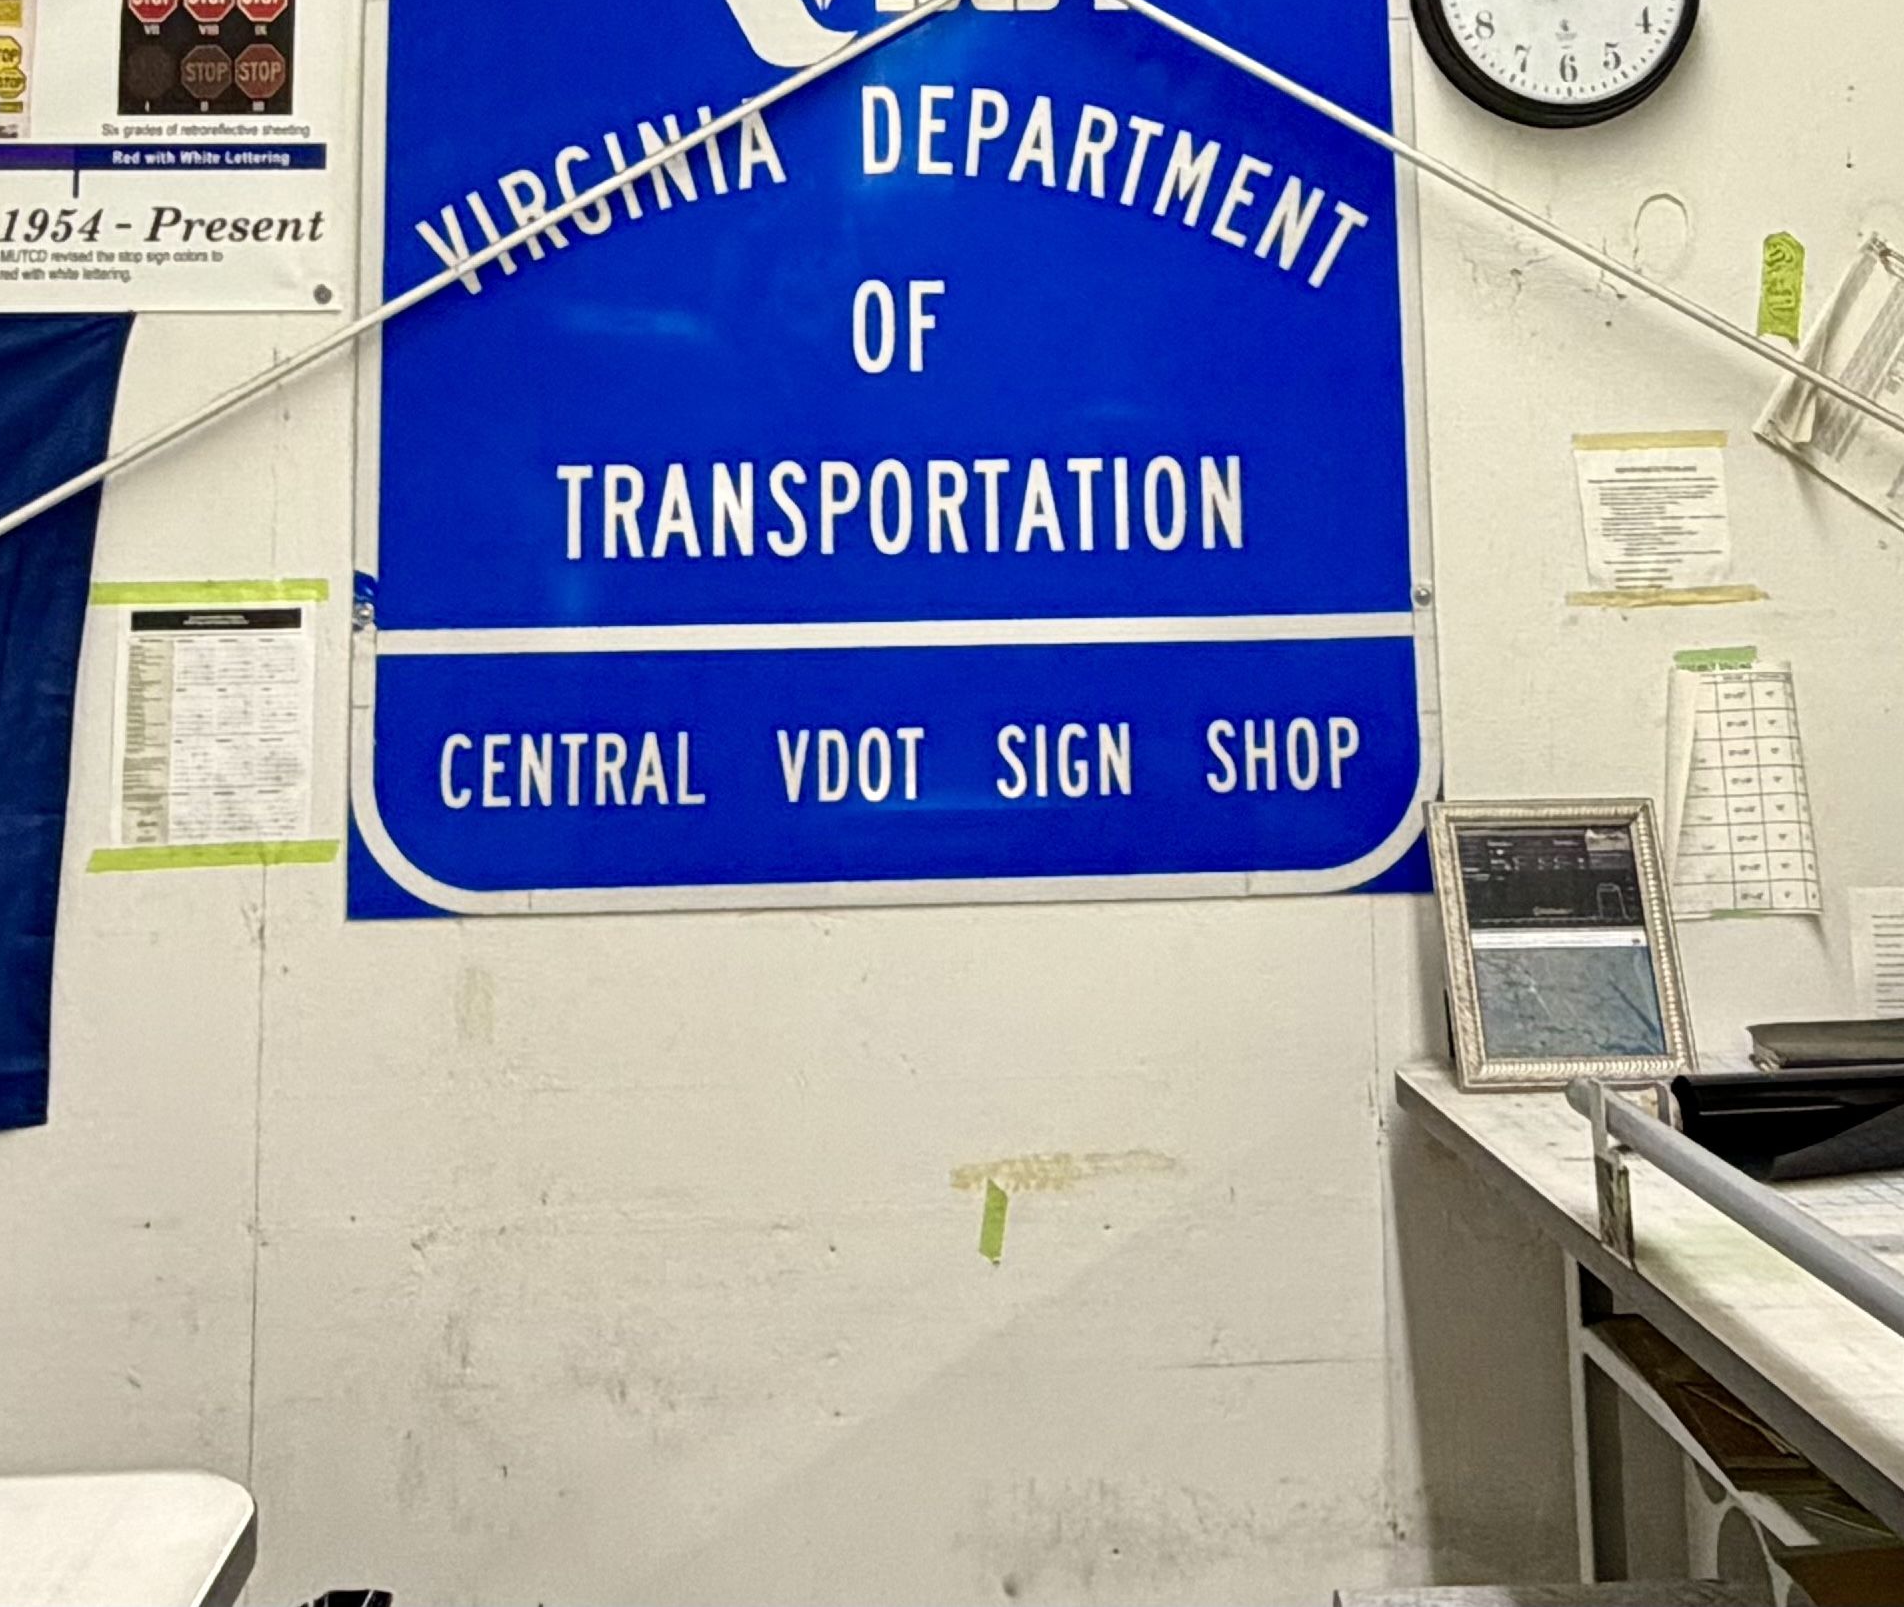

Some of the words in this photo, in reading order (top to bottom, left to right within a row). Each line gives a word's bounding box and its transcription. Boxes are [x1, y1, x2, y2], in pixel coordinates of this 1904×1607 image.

[1475, 10, 1495, 39] 8
[1635, 6, 1653, 34] 4
[239, 61, 282, 81] STOP
[1514, 44, 1531, 73] 7
[1560, 54, 1578, 83] 6
[1603, 43, 1621, 71] 5
[185, 62, 228, 82] STOP
[112, 150, 140, 165] Red
[145, 150, 176, 165] with
[180, 150, 221, 165] White
[225, 150, 290, 167] Lettering
[415, 99, 786, 294] VIRGINIA
[862, 85, 1367, 288] DEPARTMENT
[143, 205, 325, 243] Present
[852, 280, 945, 373] OF
[558, 455, 1243, 559] TRANSPORTATION
[440, 731, 705, 808] CENTRAL
[778, 727, 924, 803] VDOT
[997, 723, 1132, 797] SIGN
[1206, 717, 1360, 793] SHOP
